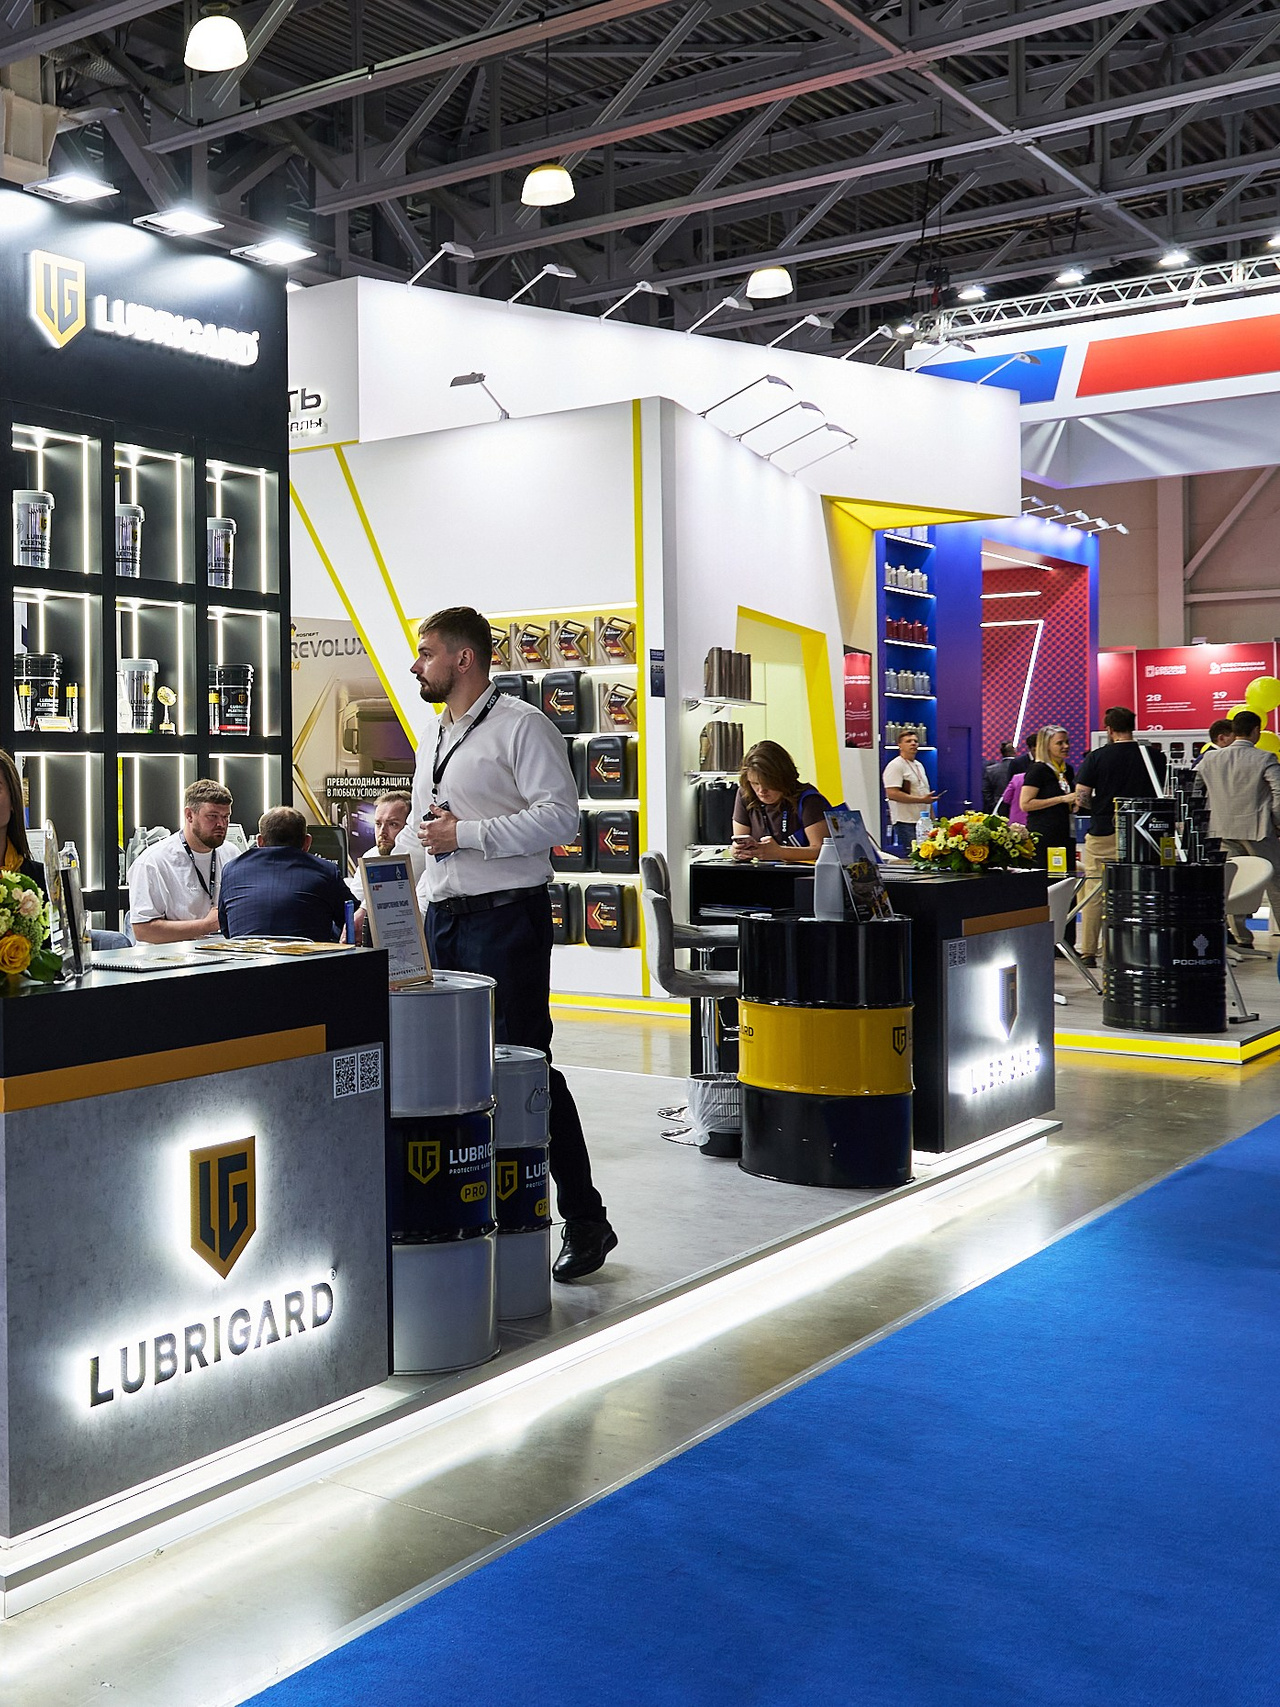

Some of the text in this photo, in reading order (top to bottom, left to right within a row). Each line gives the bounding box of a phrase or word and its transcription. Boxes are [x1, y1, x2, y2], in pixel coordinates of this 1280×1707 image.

[1145, 694, 1162, 702] 28
[1212, 691, 1228, 699] 19
[327, 777, 410, 788] ПРЕВОСХОДНАЯ ЗАЩИТА
[327, 788, 331, 797] В
[332, 788, 356, 797] ЛЮБЫХ
[449, 1166, 480, 1175] PROTECTIVE
[464, 1184, 485, 1199] PRO
[90, 1282, 335, 1407] LUBRIGARD
